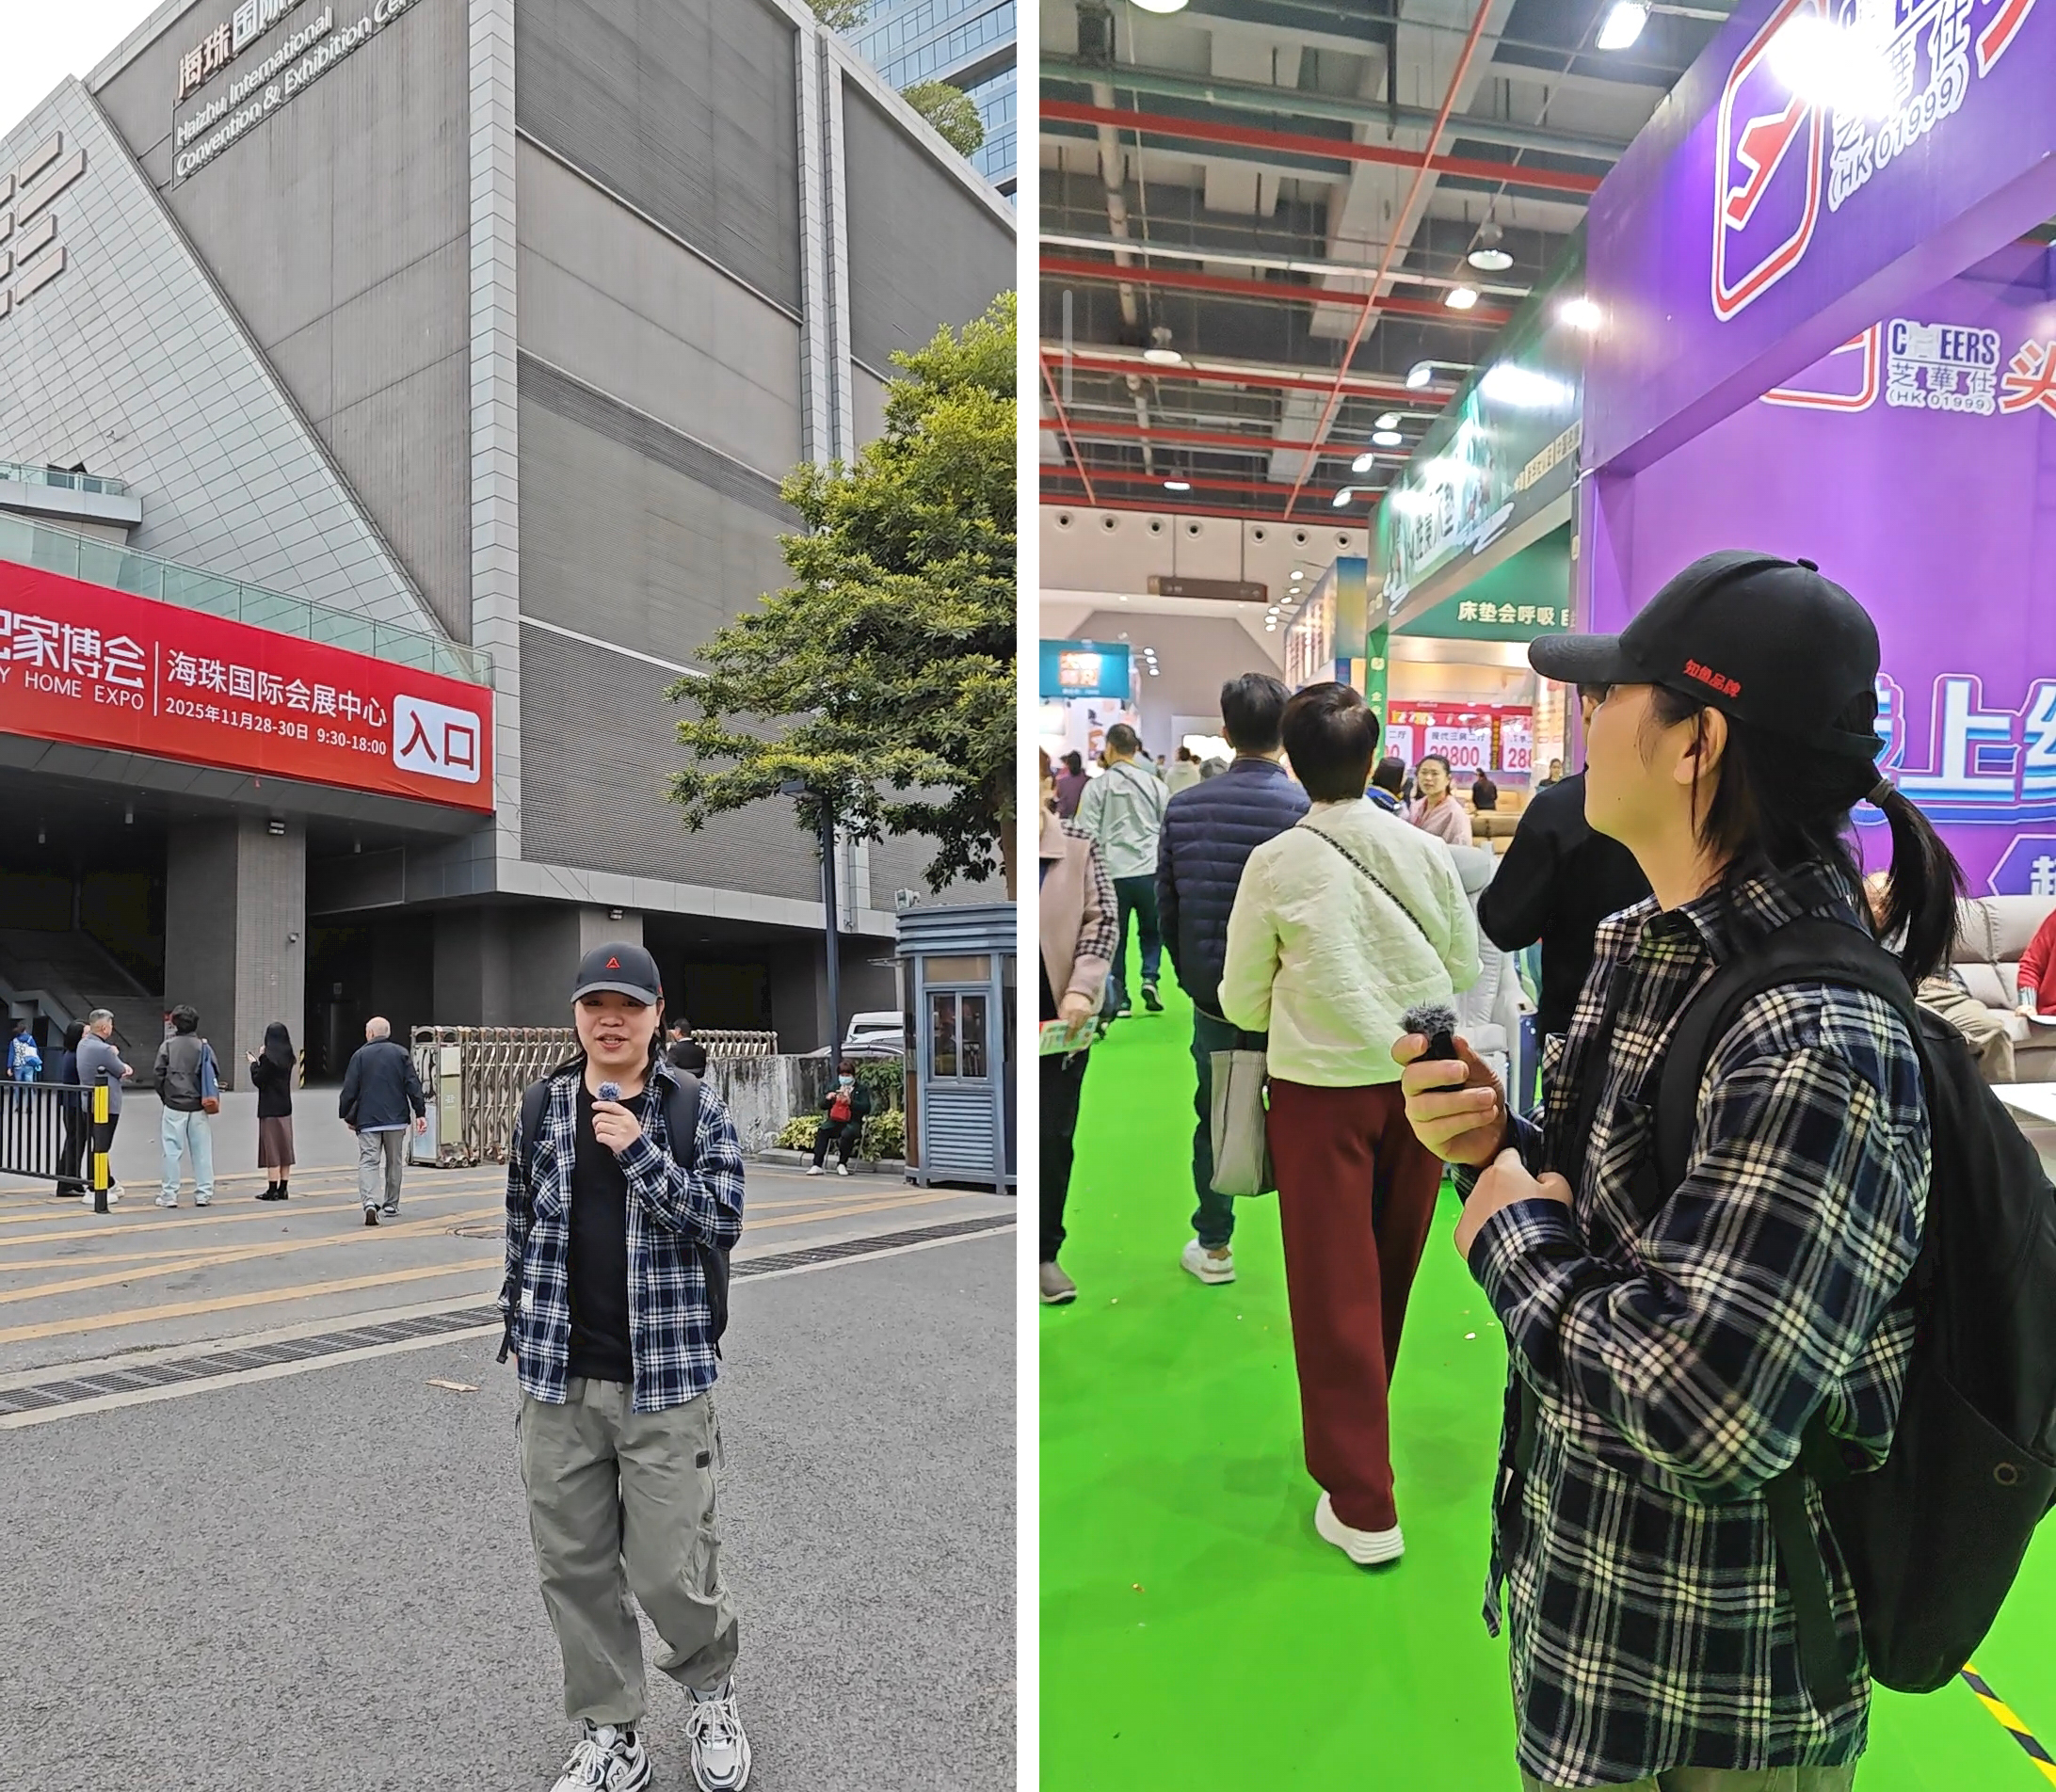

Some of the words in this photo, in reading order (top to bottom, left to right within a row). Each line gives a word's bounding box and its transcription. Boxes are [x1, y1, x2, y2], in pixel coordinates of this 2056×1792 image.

[176, 101, 263, 177] Convention
[263, 84, 282, 110] &
[284, 16, 373, 95] Exhibition
[177, 96, 228, 146] Haizhu
[229, 6, 332, 104] International
[1892, 323, 1996, 365] CEERS
[1457, 600, 1555, 626] 床垫会呼吸
[0, 609, 147, 690] 家博会
[24, 669, 82, 698] HOME
[94, 684, 144, 711] EXPO
[167, 648, 388, 728] 海珠国际会展中心
[165, 696, 309, 741] 2025年11月28-30日
[316, 727, 387, 756] 9:30-18:00
[400, 710, 475, 772] 入口
